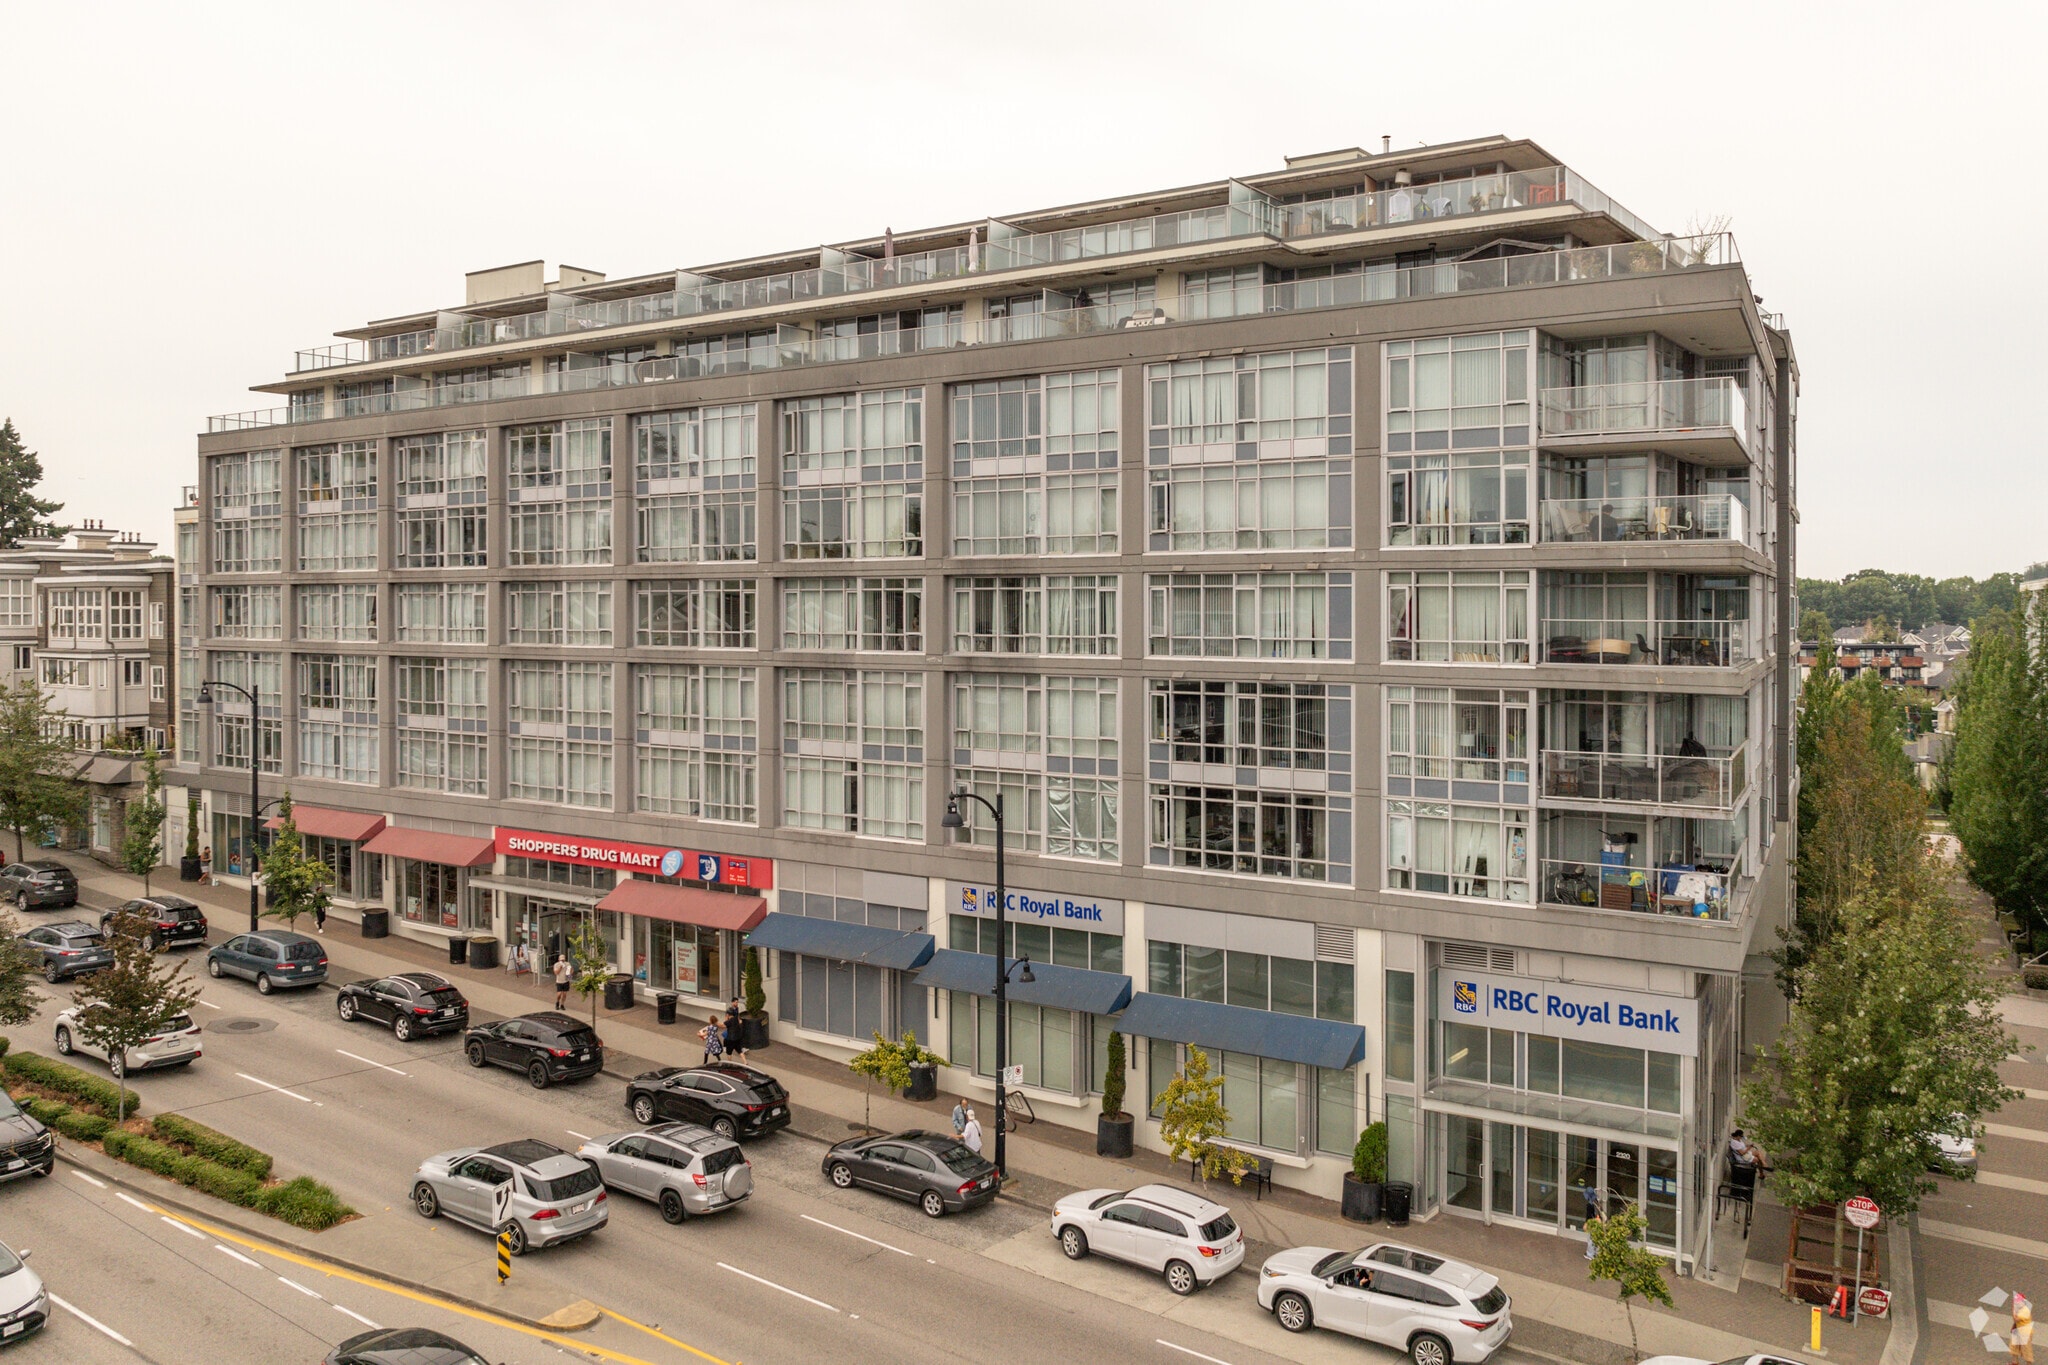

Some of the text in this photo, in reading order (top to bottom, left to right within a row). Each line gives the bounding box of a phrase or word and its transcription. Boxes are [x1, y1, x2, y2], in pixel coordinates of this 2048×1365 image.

[508, 837, 660, 867] SHOPPERS DRUG MART
[987, 891, 1102, 921] RC Royal Bank
[1455, 1003, 1475, 1013] RBC
[1493, 988, 1681, 1033] RBC Royal Bank
[1852, 1199, 1873, 1210] STOP
[1863, 1303, 1881, 1312] ENTER
